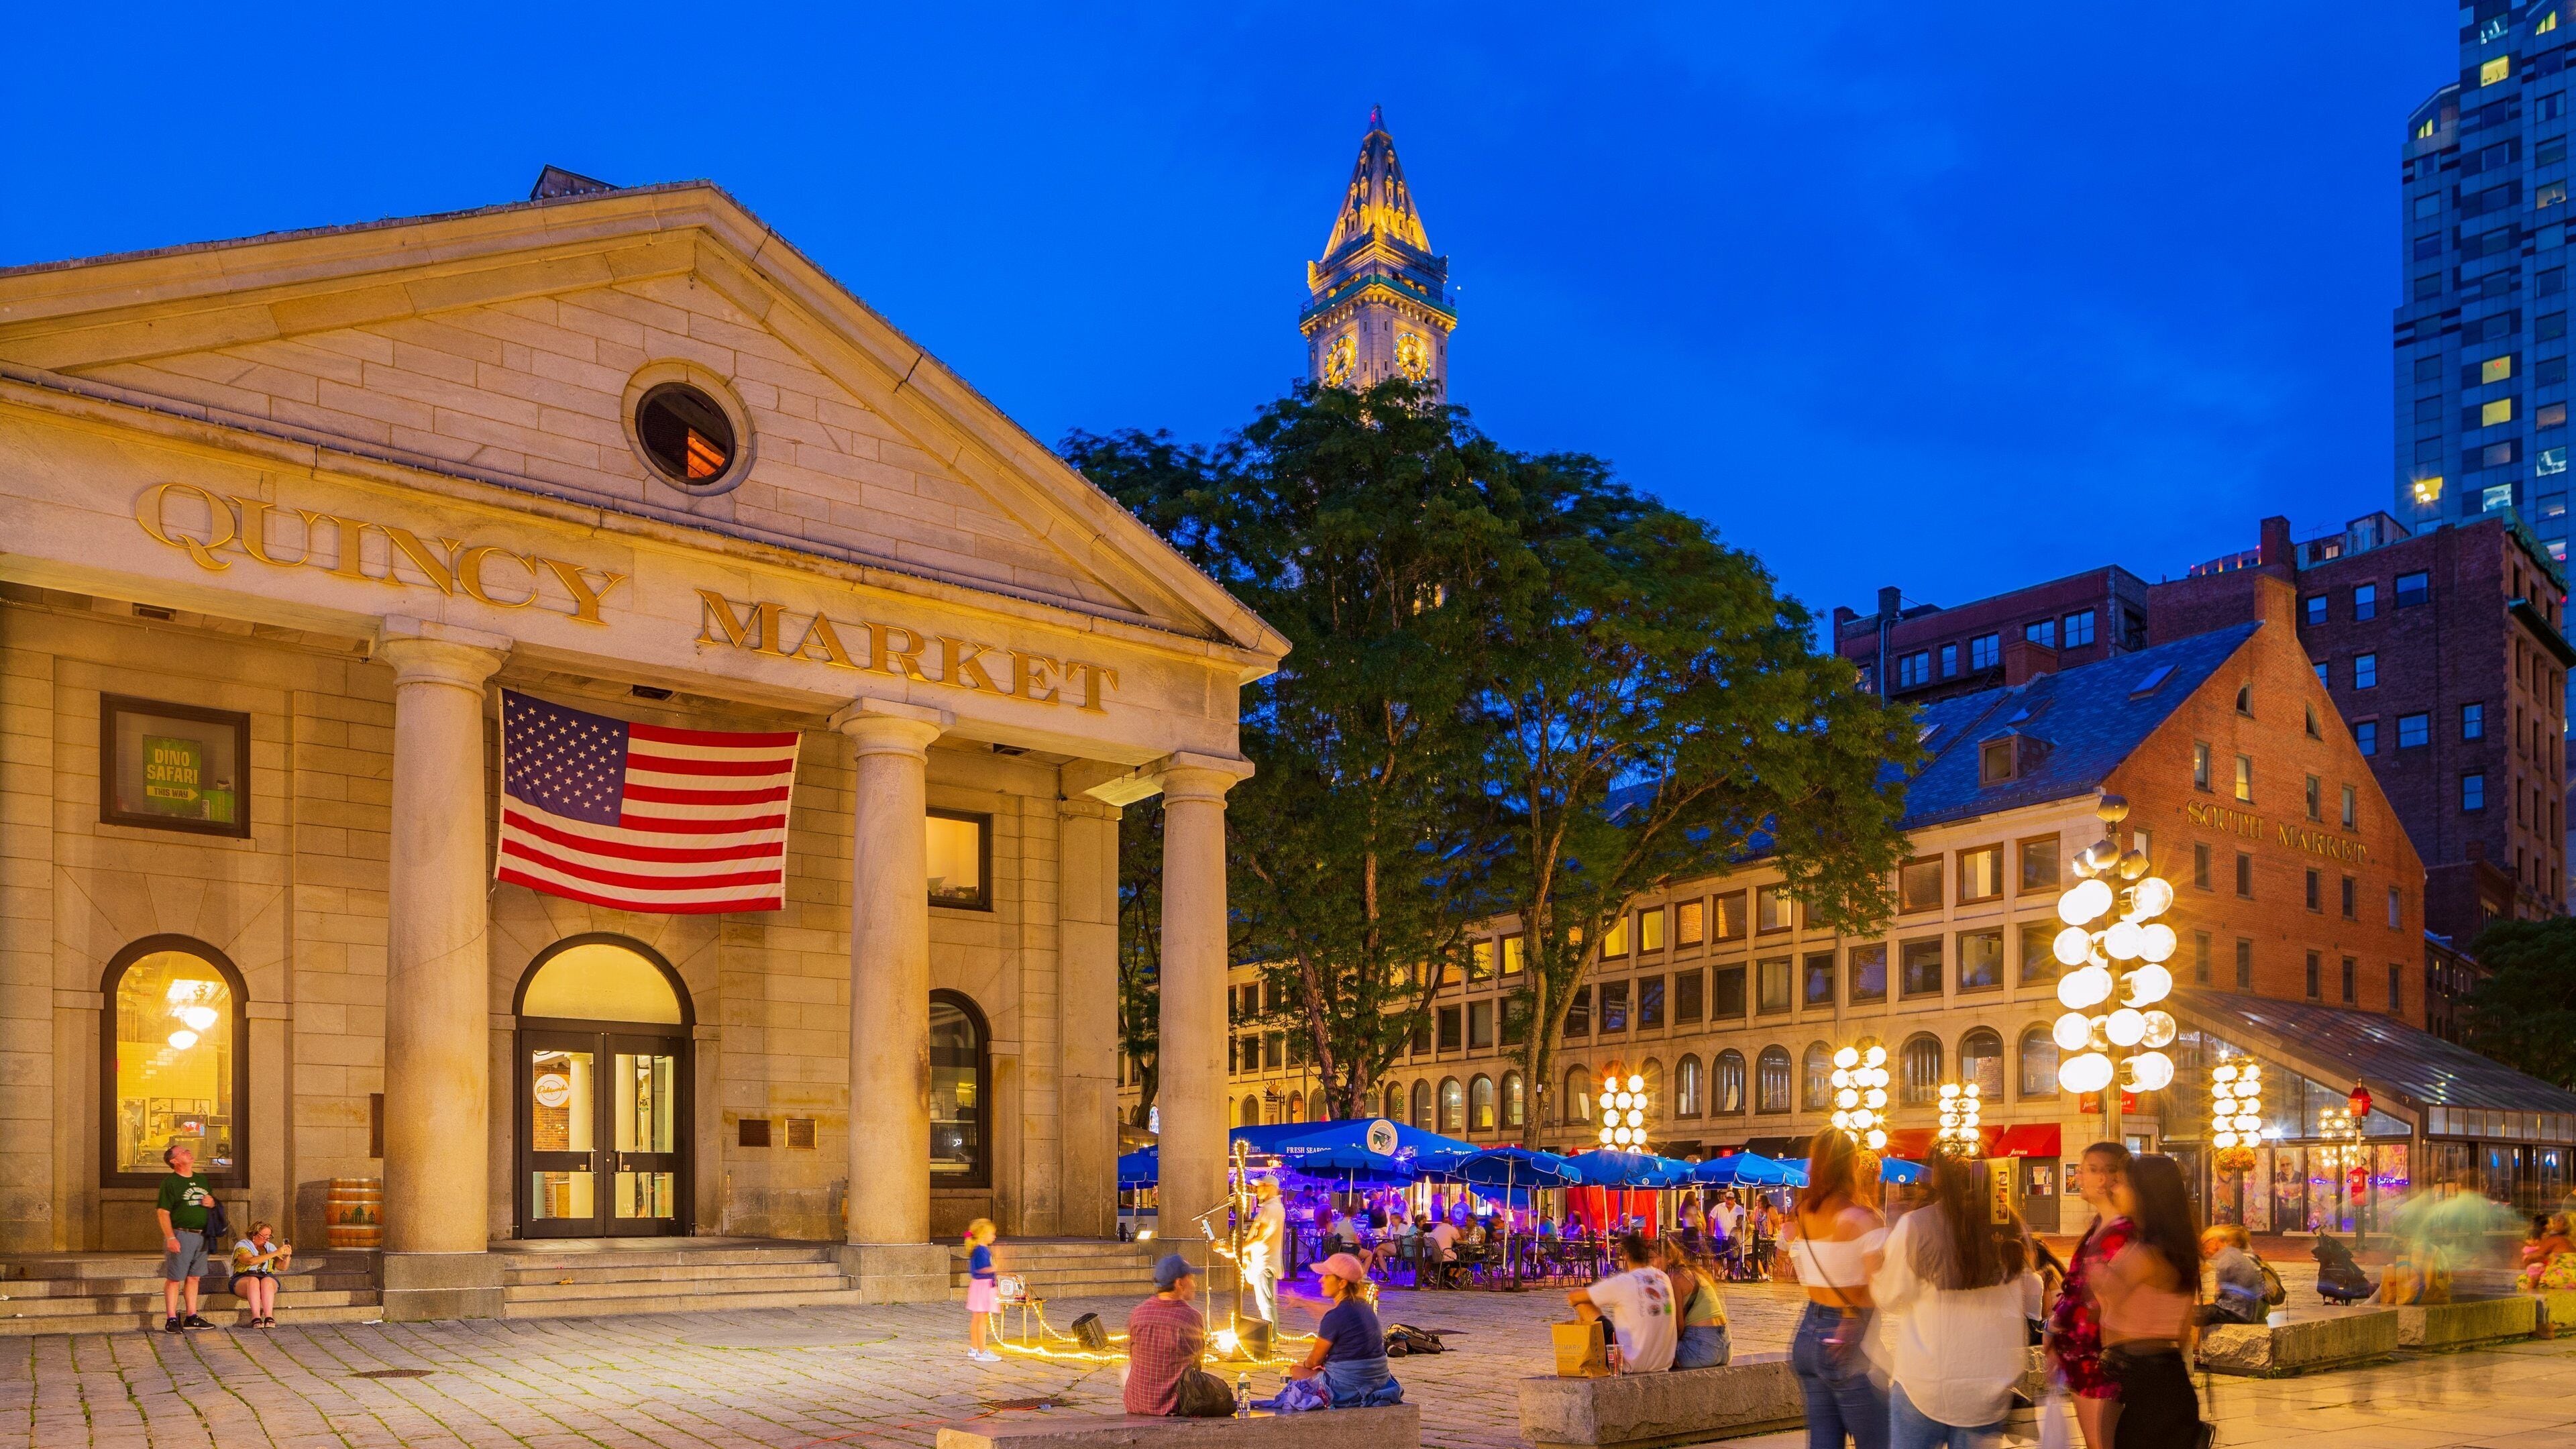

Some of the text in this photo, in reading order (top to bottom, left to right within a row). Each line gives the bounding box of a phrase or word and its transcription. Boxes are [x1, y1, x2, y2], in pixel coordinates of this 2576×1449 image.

[136, 482, 1118, 714] QUINCY MARKET
[154, 748, 191, 767] DINO
[147, 764, 198, 785] SAFARI
[154, 788, 188, 798] THIS WAY
[2187, 800, 2367, 864] SOUTH MARKET
